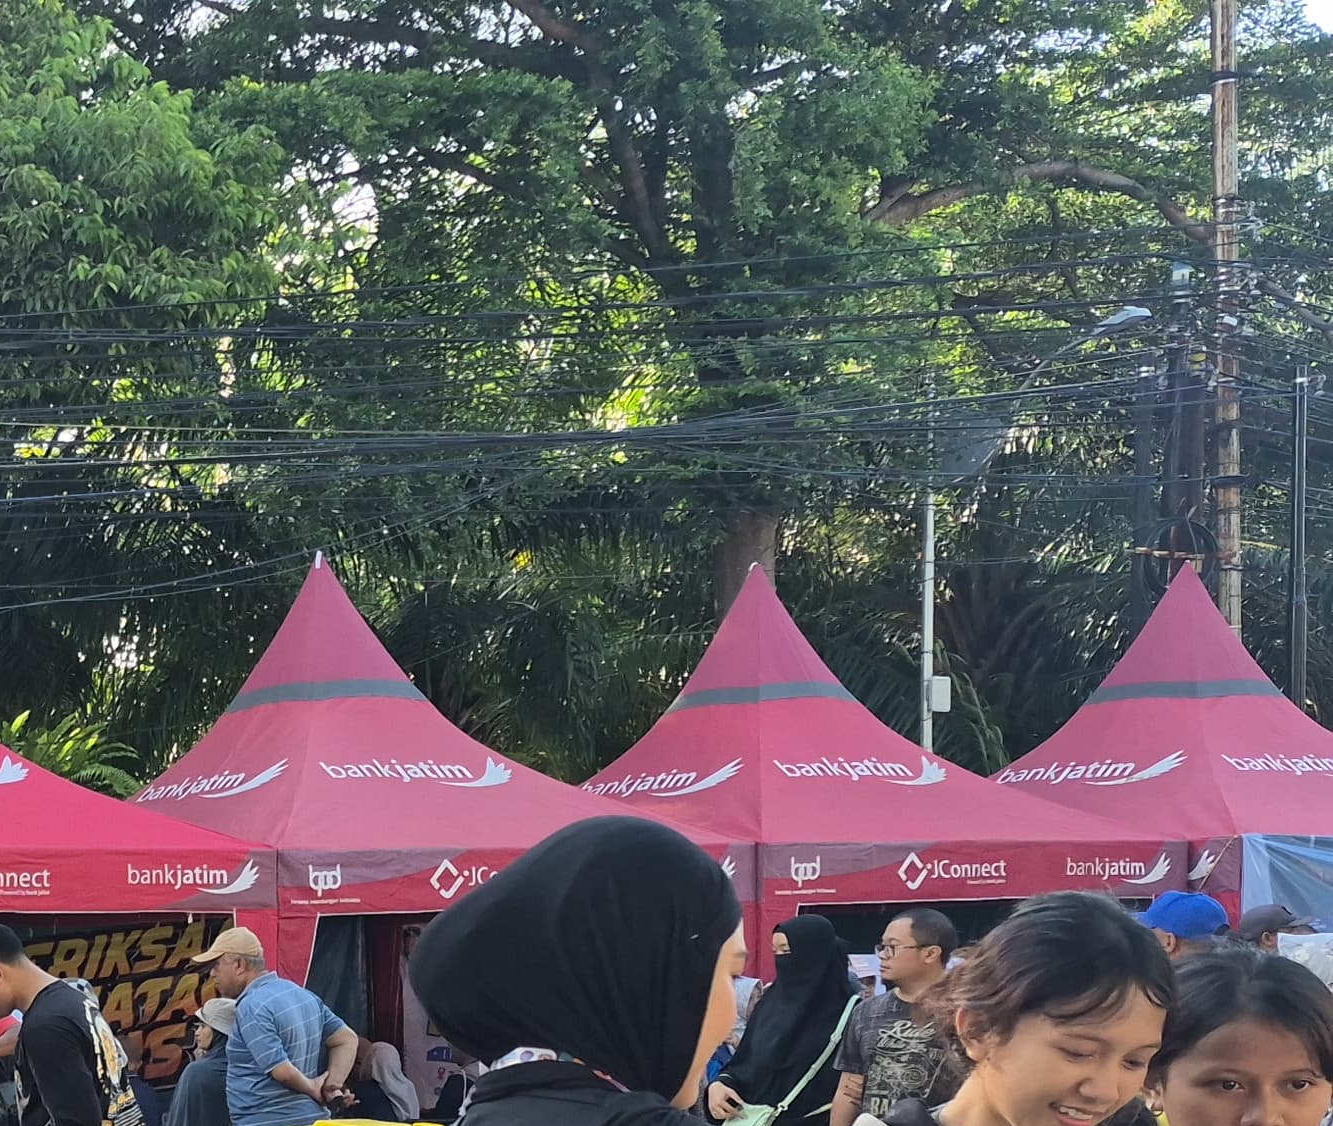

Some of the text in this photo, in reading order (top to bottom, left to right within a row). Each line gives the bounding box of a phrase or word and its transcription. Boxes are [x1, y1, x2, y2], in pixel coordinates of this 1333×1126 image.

[319, 759, 473, 782] bankjatim
[773, 757, 914, 781] bankjatim
[996, 760, 1135, 784] bankjatim
[136, 769, 246, 802] bankjatim
[128, 864, 228, 889] bankjatim
[931, 860, 1008, 879] JConnect
[1066, 858, 1145, 879] bankjatim
[878, 1020, 936, 1042] Ride
